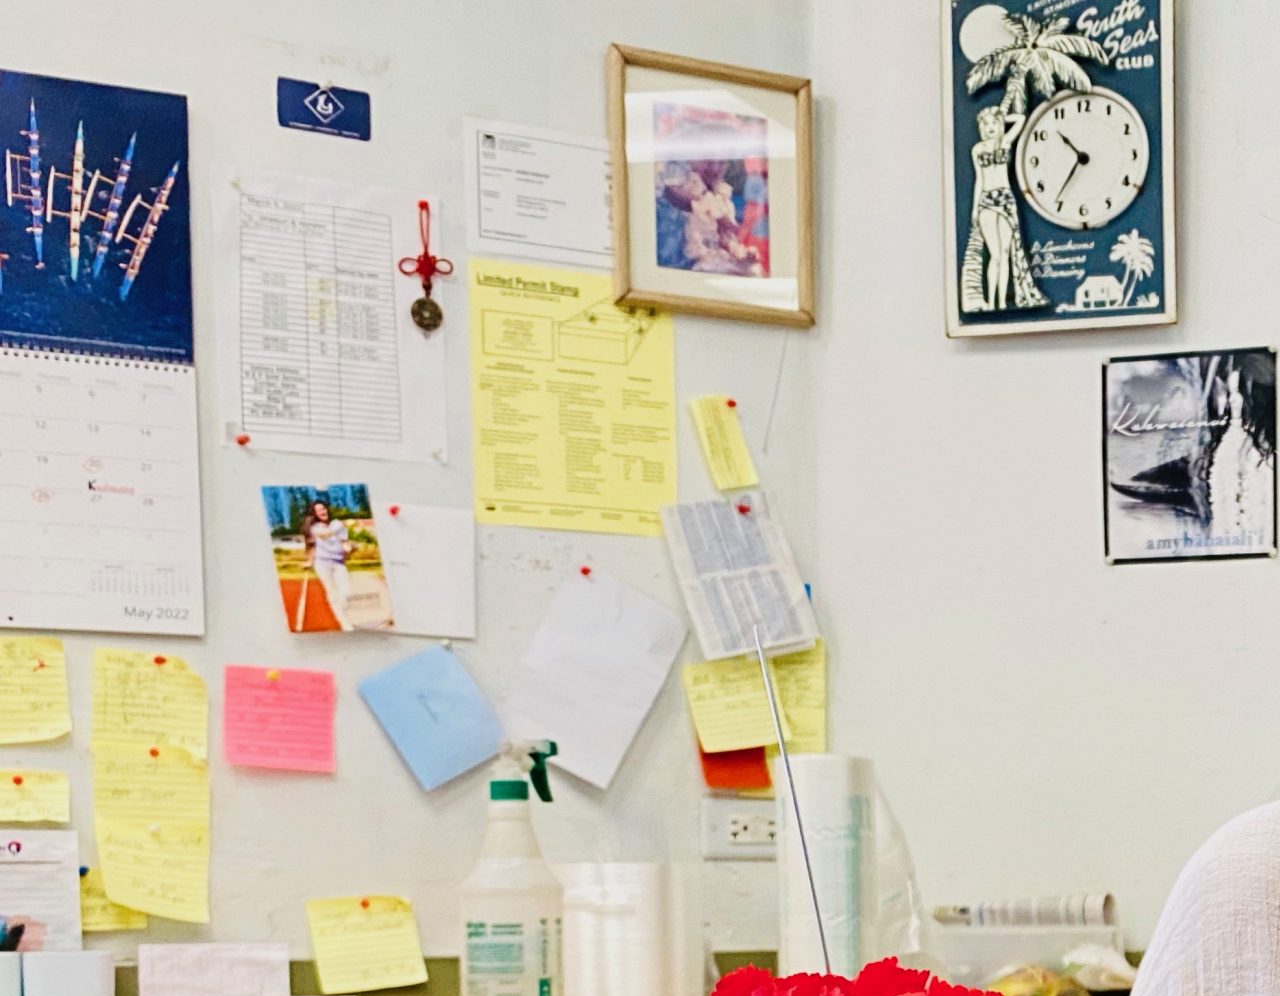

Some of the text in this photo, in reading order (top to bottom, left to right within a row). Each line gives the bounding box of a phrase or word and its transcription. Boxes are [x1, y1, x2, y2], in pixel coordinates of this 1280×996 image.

[1076, 0, 1146, 37] South
[1103, 20, 1160, 60] Seas
[1115, 54, 1155, 71] CLUB
[1077, 99, 1091, 113] 12
[1106, 104, 1112, 116] 1
[1055, 108, 1066, 120] 11
[1033, 130, 1048, 142] 10
[1124, 123, 1131, 136] 2
[1131, 148, 1138, 161] 3
[1029, 156, 1040, 168] 9
[1036, 180, 1046, 193] 8
[1122, 174, 1131, 187] 4
[1055, 199, 1064, 213] 7
[1104, 197, 1113, 210] 5
[1078, 204, 1089, 217] 6
[124, 604, 190, 623] May 2022
